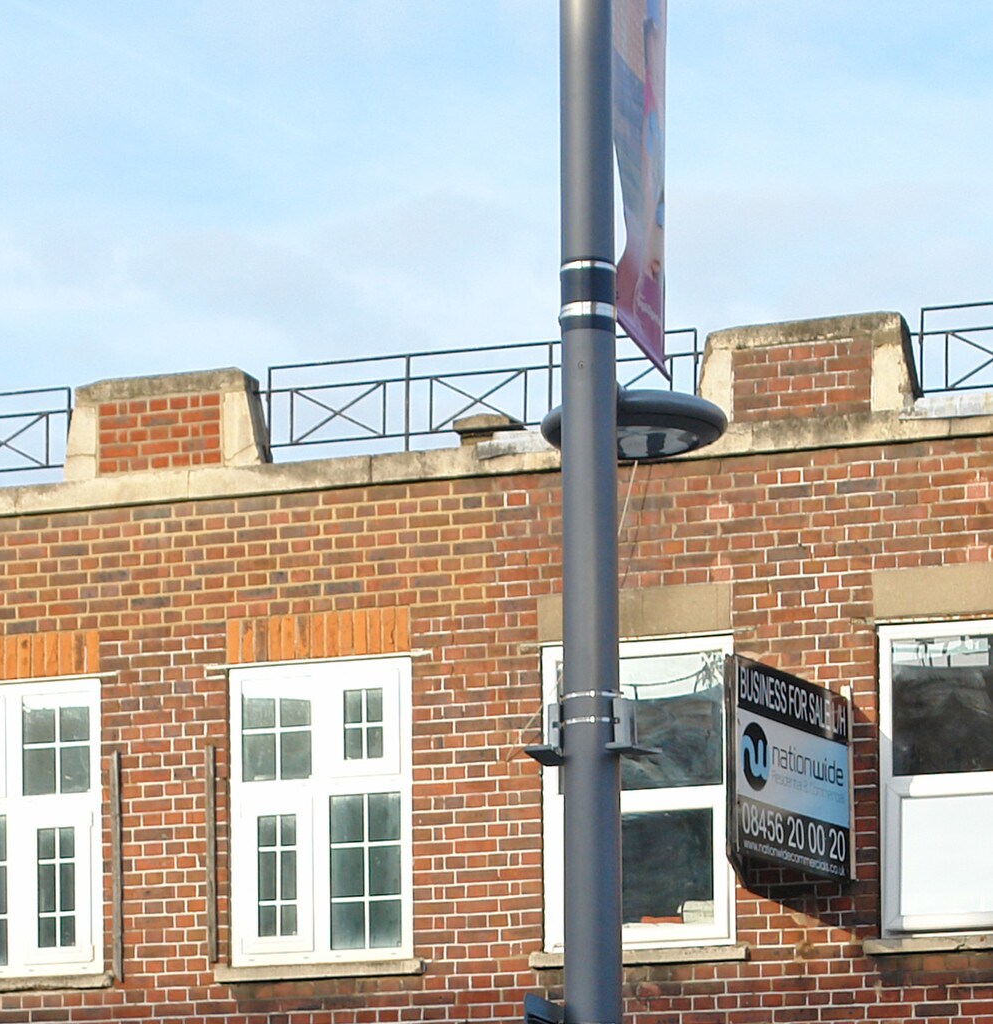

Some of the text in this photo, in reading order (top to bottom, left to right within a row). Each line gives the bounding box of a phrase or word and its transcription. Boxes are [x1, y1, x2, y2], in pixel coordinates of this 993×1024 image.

[740, 666, 787, 713] BUSINESS
[788, 684, 807, 721] FOR
[809, 693, 831, 731] SALE
[771, 745, 844, 787] nationwide
[742, 802, 846, 862] 08456 20 00 20
